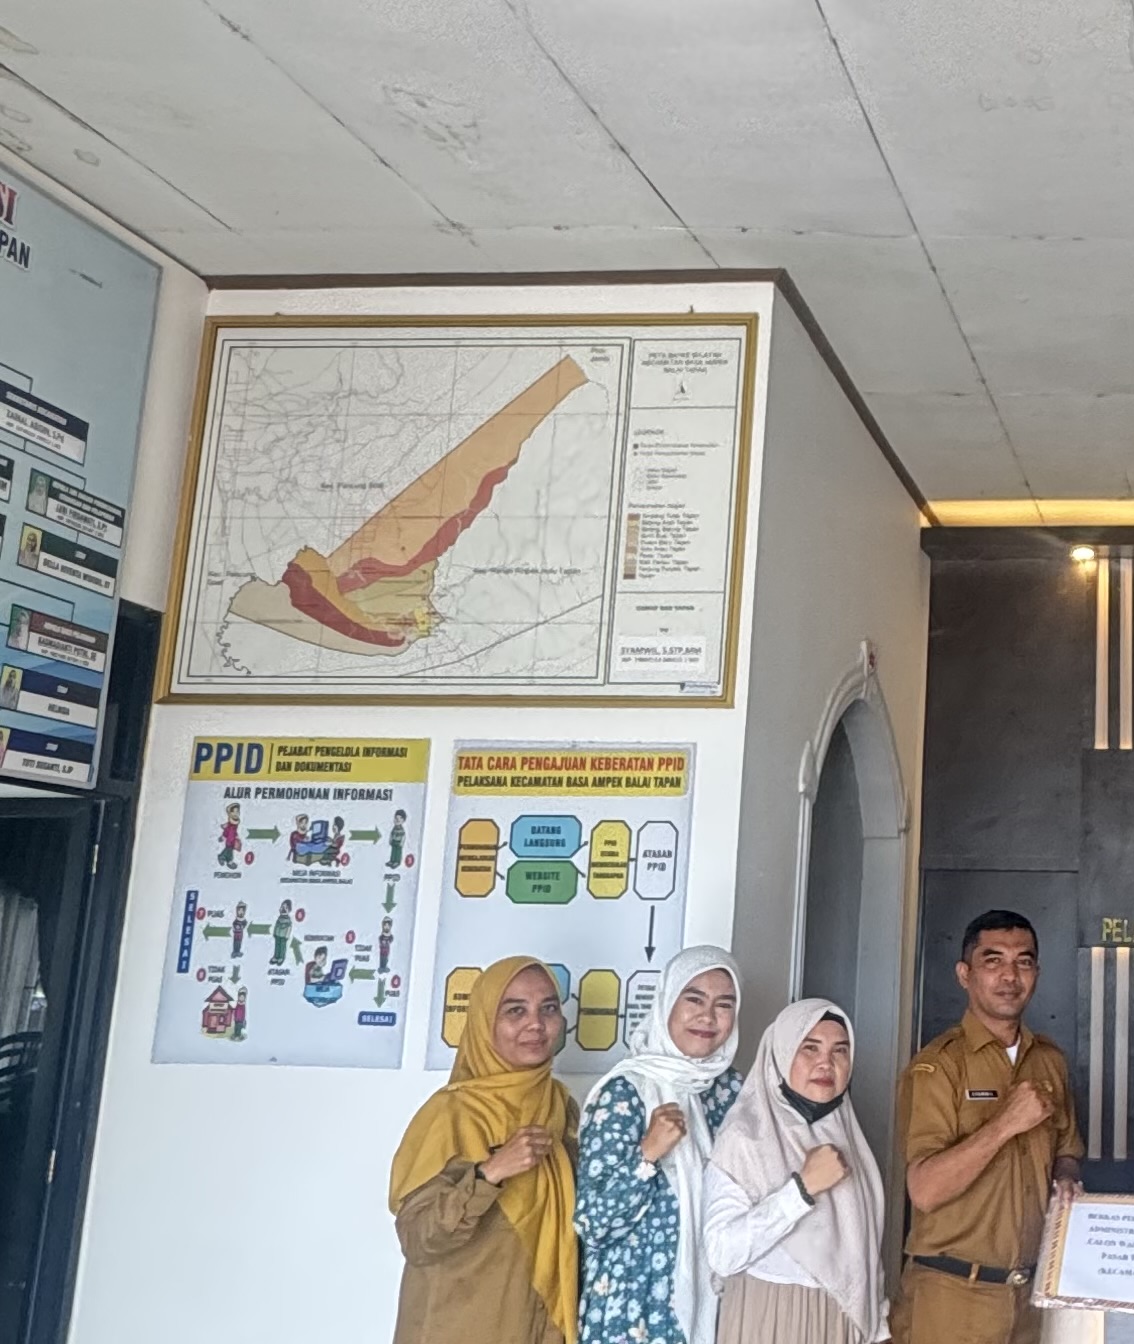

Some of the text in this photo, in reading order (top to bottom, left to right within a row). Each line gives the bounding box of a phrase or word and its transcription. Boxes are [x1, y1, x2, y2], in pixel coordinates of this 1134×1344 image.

[193, 742, 264, 774] PPID
[278, 746, 408, 758] PEJABAT PENGELOLA INFORMASI
[275, 761, 352, 773] DAN DOKUMENTASI
[458, 756, 685, 772] TATA CARA PENGAJUAN KEBERATAN PPID
[457, 775, 681, 789] PELAKSANA KECAMATAN BASA AMPEK BALAI TAPAN
[224, 786, 394, 802] ALUR PERMOHONAN INFORMASI
